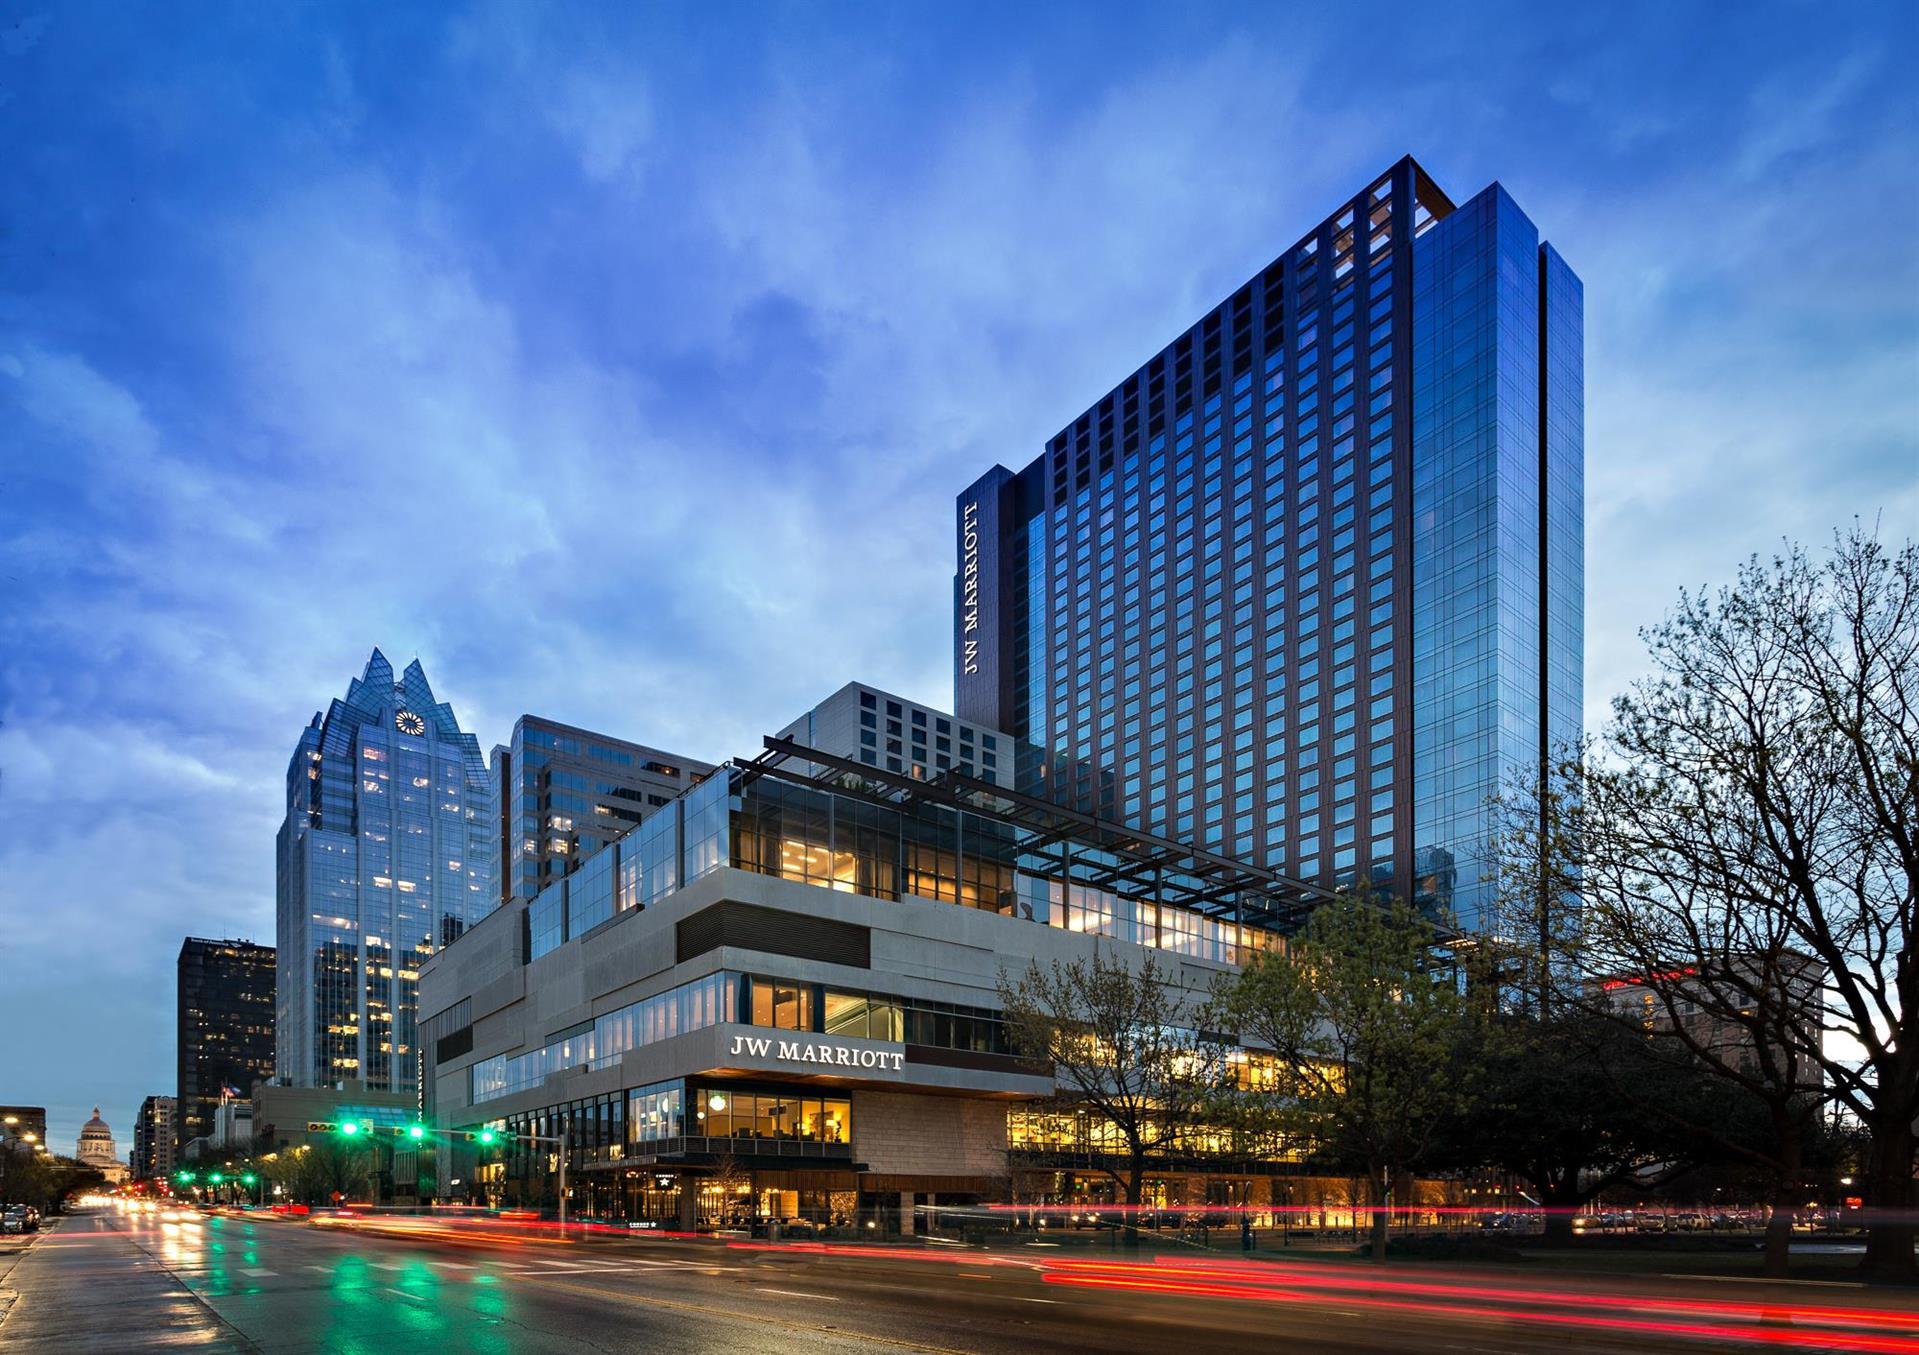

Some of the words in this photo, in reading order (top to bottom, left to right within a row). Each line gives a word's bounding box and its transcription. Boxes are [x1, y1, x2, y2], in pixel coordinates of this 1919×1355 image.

[964, 502, 978, 634] MARRIOTT
[964, 640, 977, 675] JW
[730, 1036, 772, 1057] JW
[777, 1041, 904, 1070] MARRIOTT
